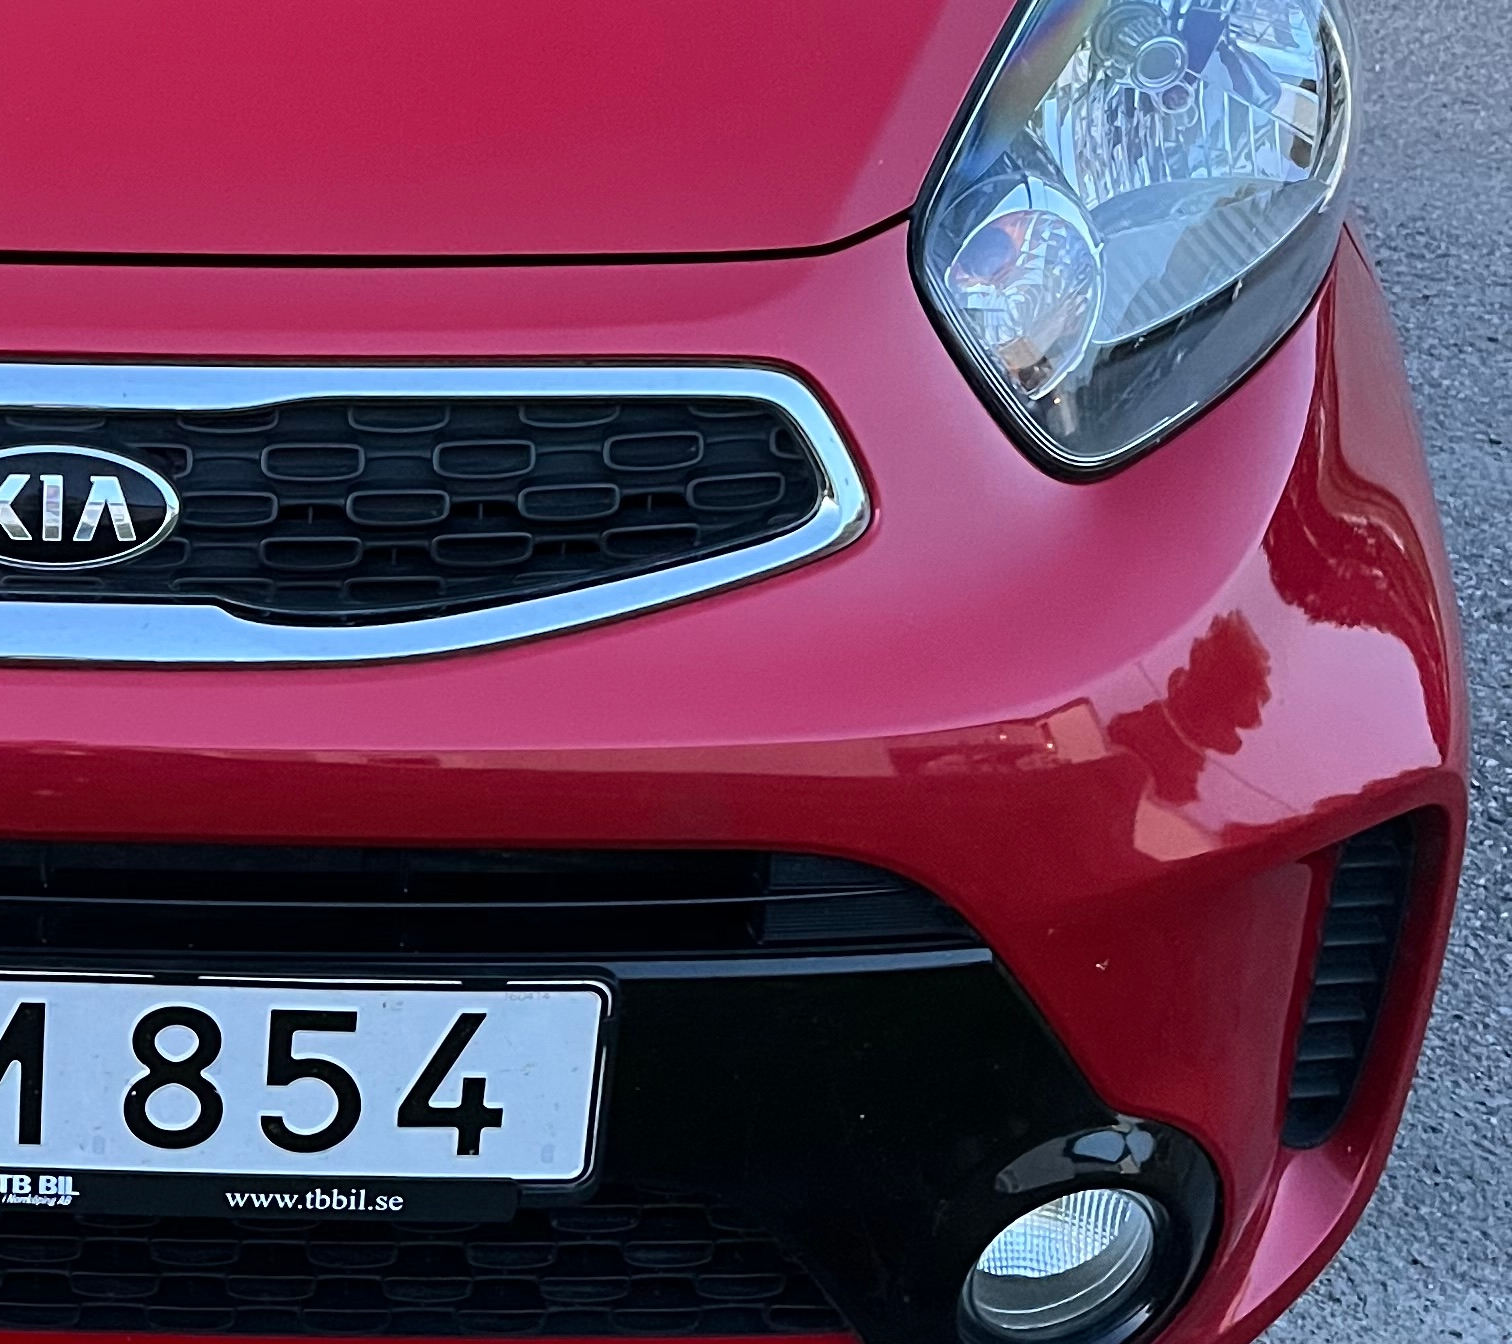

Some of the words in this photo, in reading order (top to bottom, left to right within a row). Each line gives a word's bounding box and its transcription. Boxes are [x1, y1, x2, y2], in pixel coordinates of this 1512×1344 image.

[123, 1005, 504, 1156] 854
[38, 1175, 80, 1196] BIL
[225, 1188, 404, 1211] www.tbbil.se
